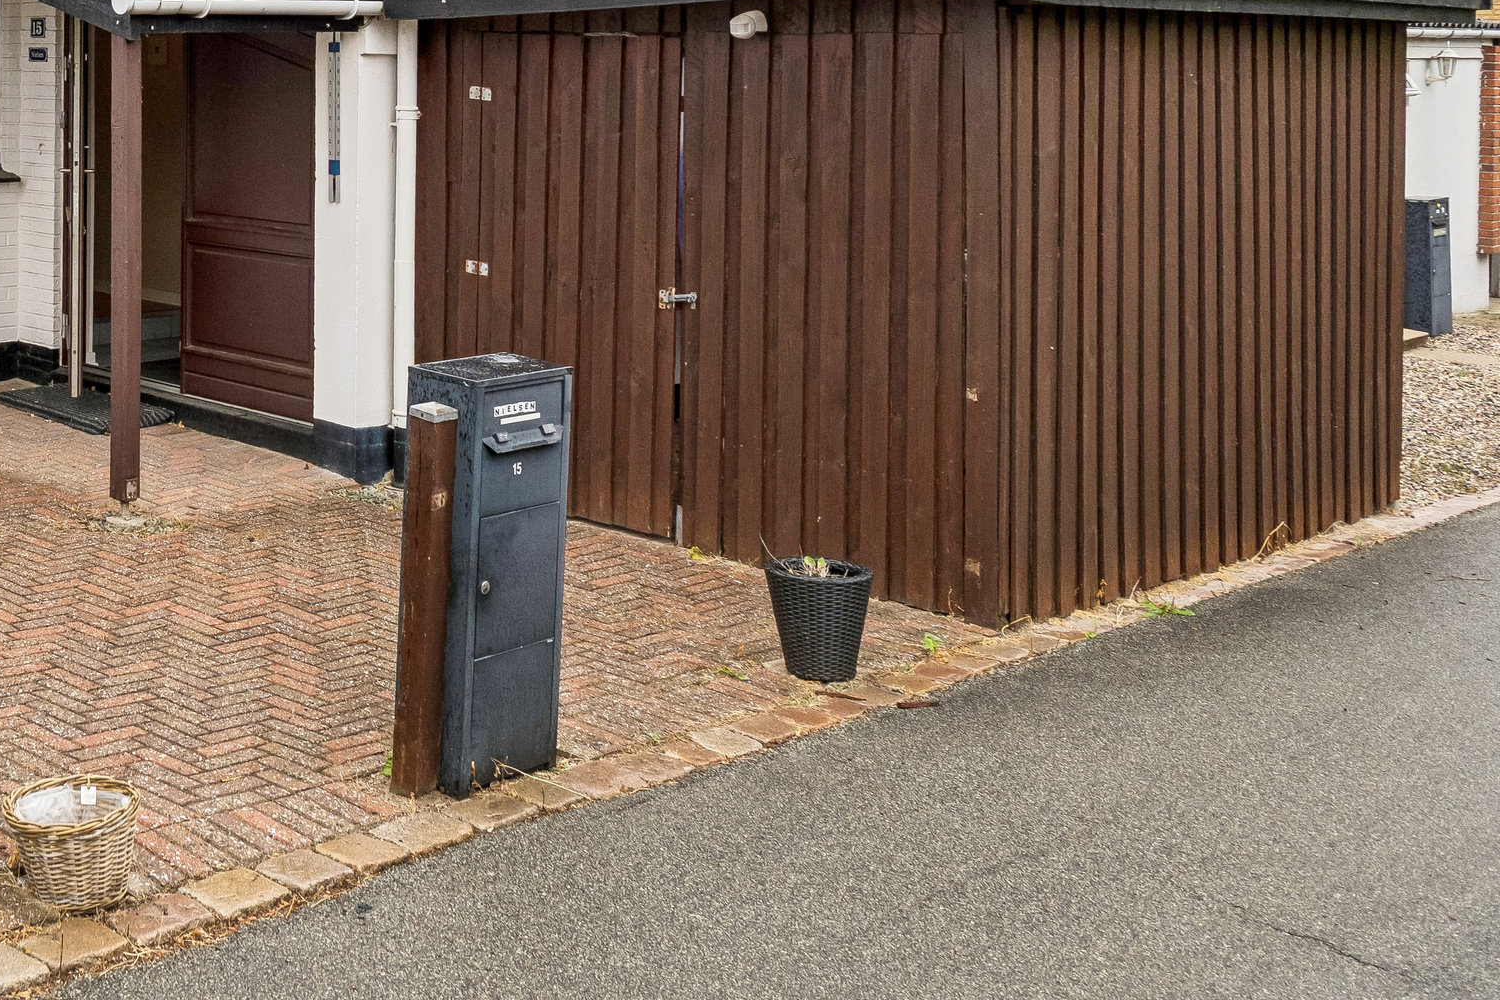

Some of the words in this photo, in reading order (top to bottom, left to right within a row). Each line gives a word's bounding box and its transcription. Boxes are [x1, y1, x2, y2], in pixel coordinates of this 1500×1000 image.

[32, 21, 42, 35] 15
[495, 403, 535, 416] NIELSEN
[513, 462, 522, 475] 15
